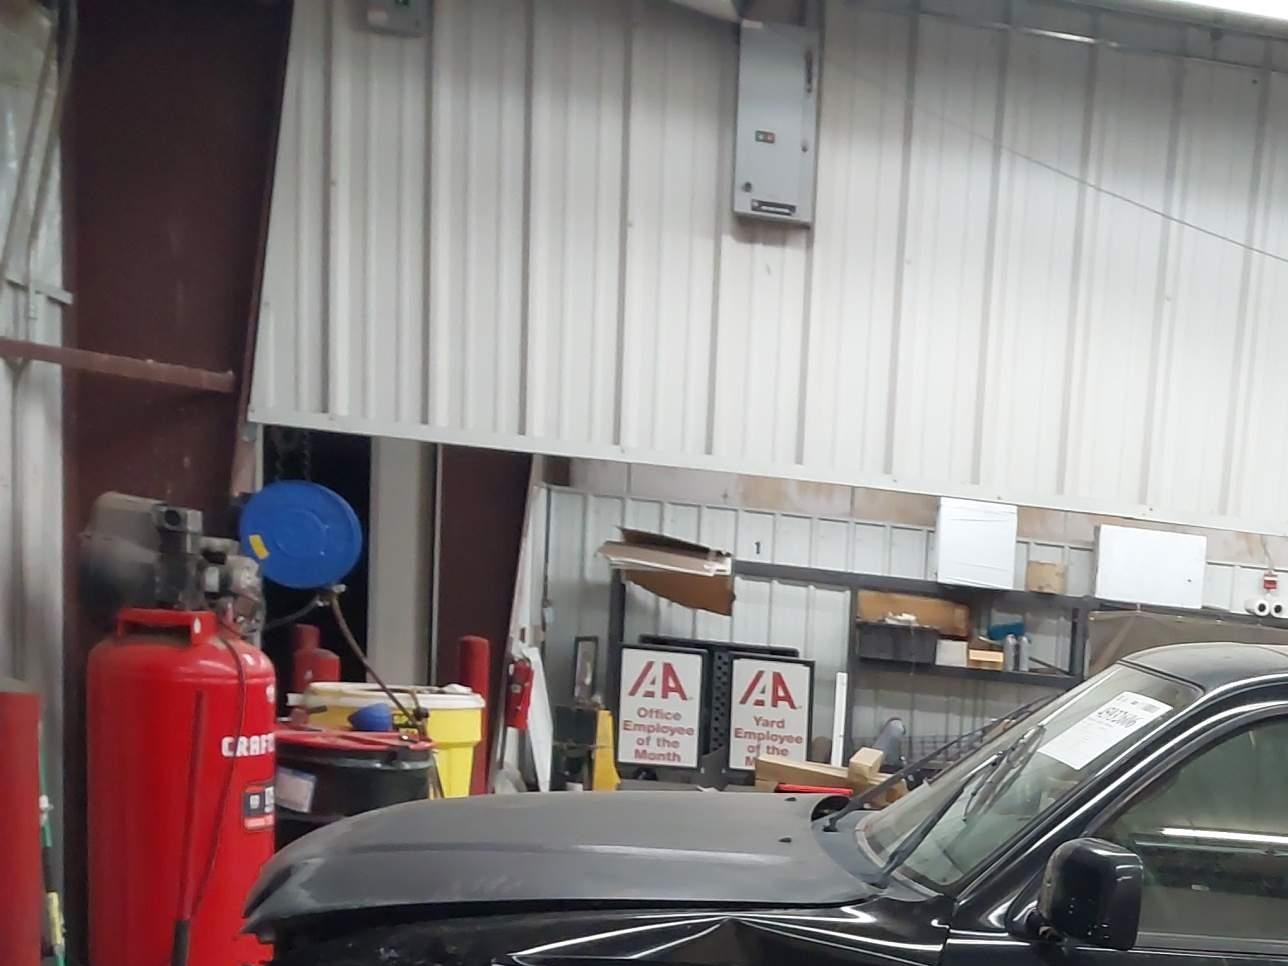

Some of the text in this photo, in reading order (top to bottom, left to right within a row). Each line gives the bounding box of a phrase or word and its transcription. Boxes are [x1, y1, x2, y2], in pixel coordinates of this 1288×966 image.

[754, 541, 761, 554] 1
[637, 707, 682, 722] Office
[623, 720, 695, 737] Employee
[753, 716, 785, 729] Yard
[636, 735, 680, 749] of the
[734, 728, 804, 745] Employee
[634, 749, 681, 763] Month
[747, 744, 789, 757] of the
